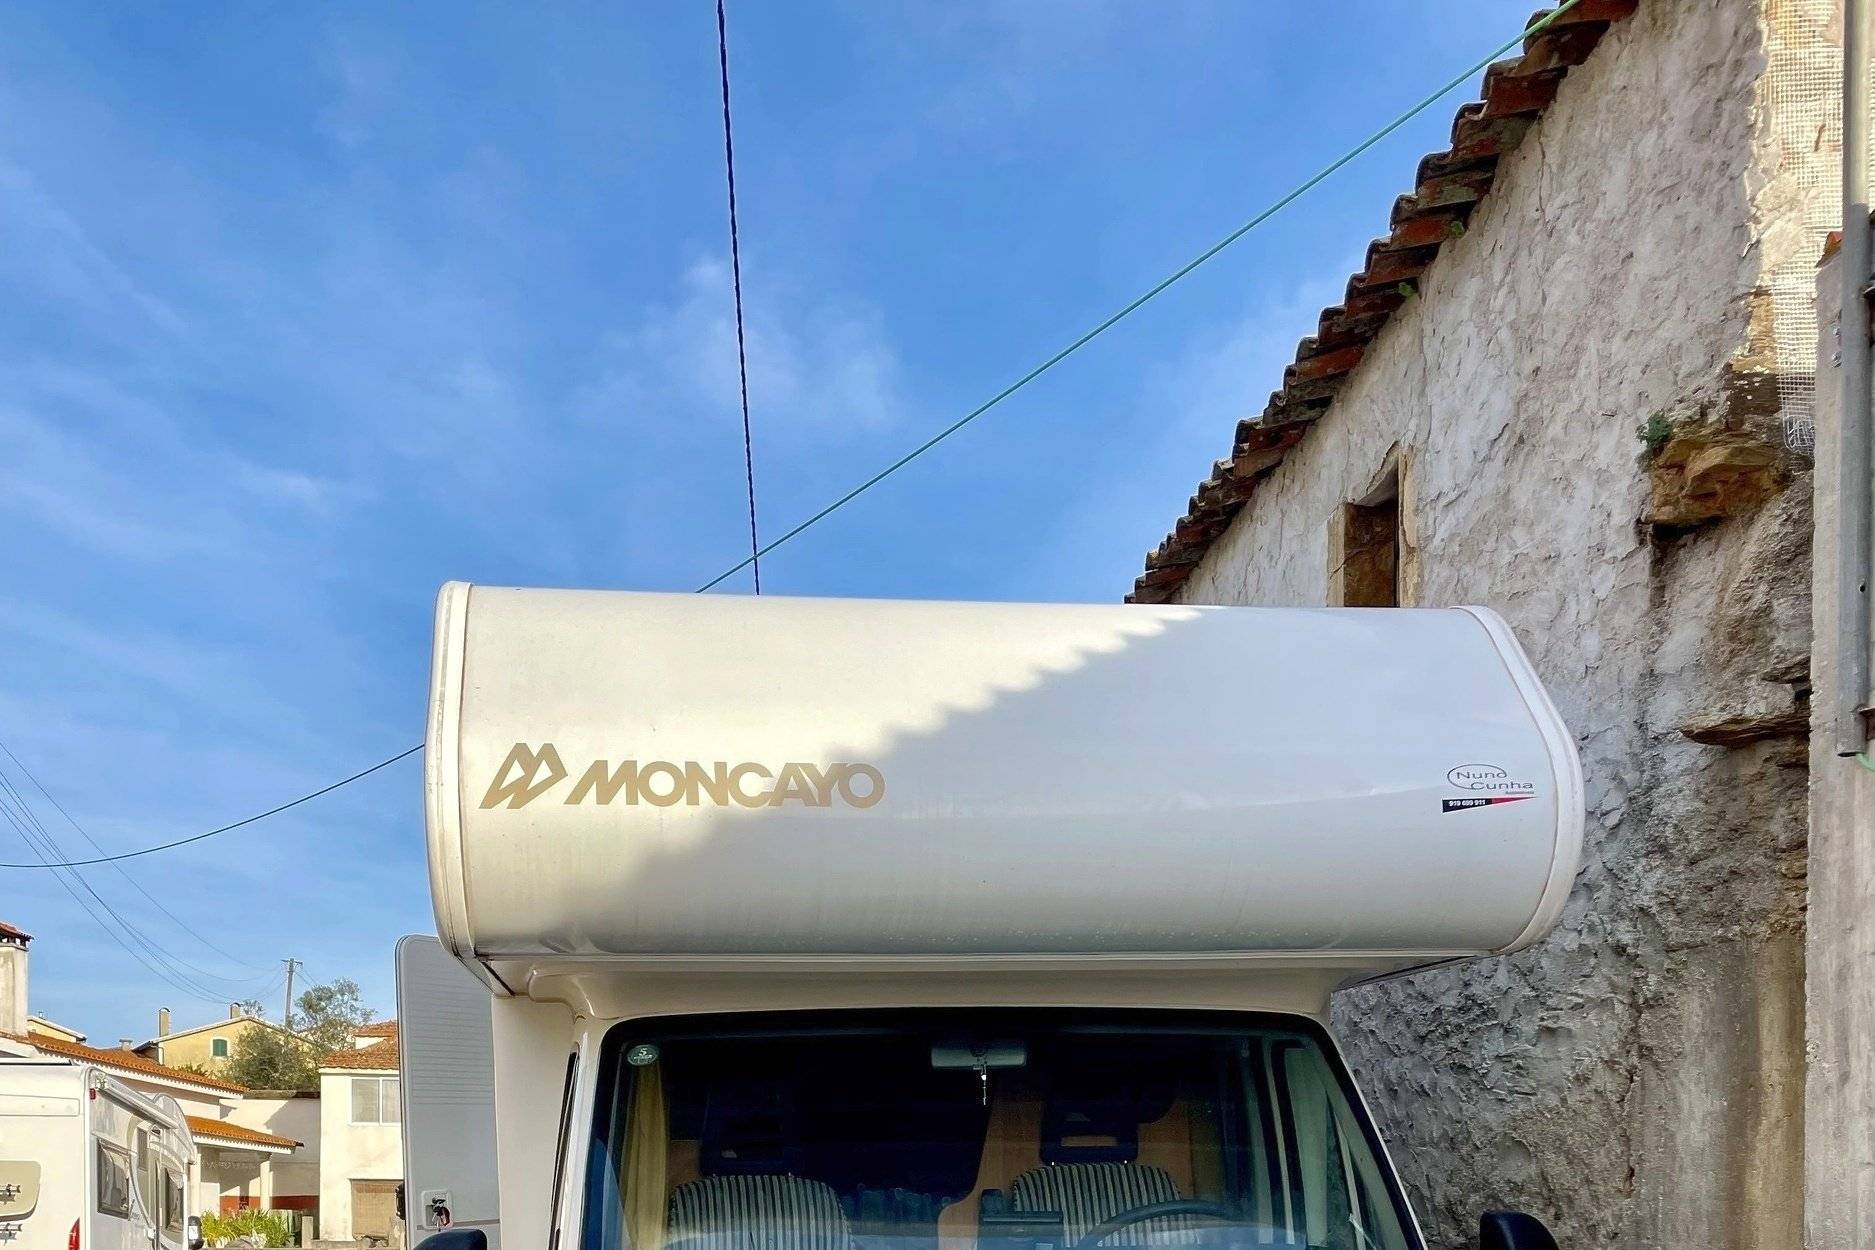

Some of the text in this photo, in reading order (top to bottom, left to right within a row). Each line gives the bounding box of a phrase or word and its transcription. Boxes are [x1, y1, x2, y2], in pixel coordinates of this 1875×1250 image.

[1457, 771, 1507, 780] Nuno
[563, 759, 886, 809] MONCAYO
[1470, 781, 1534, 790] Cunha
